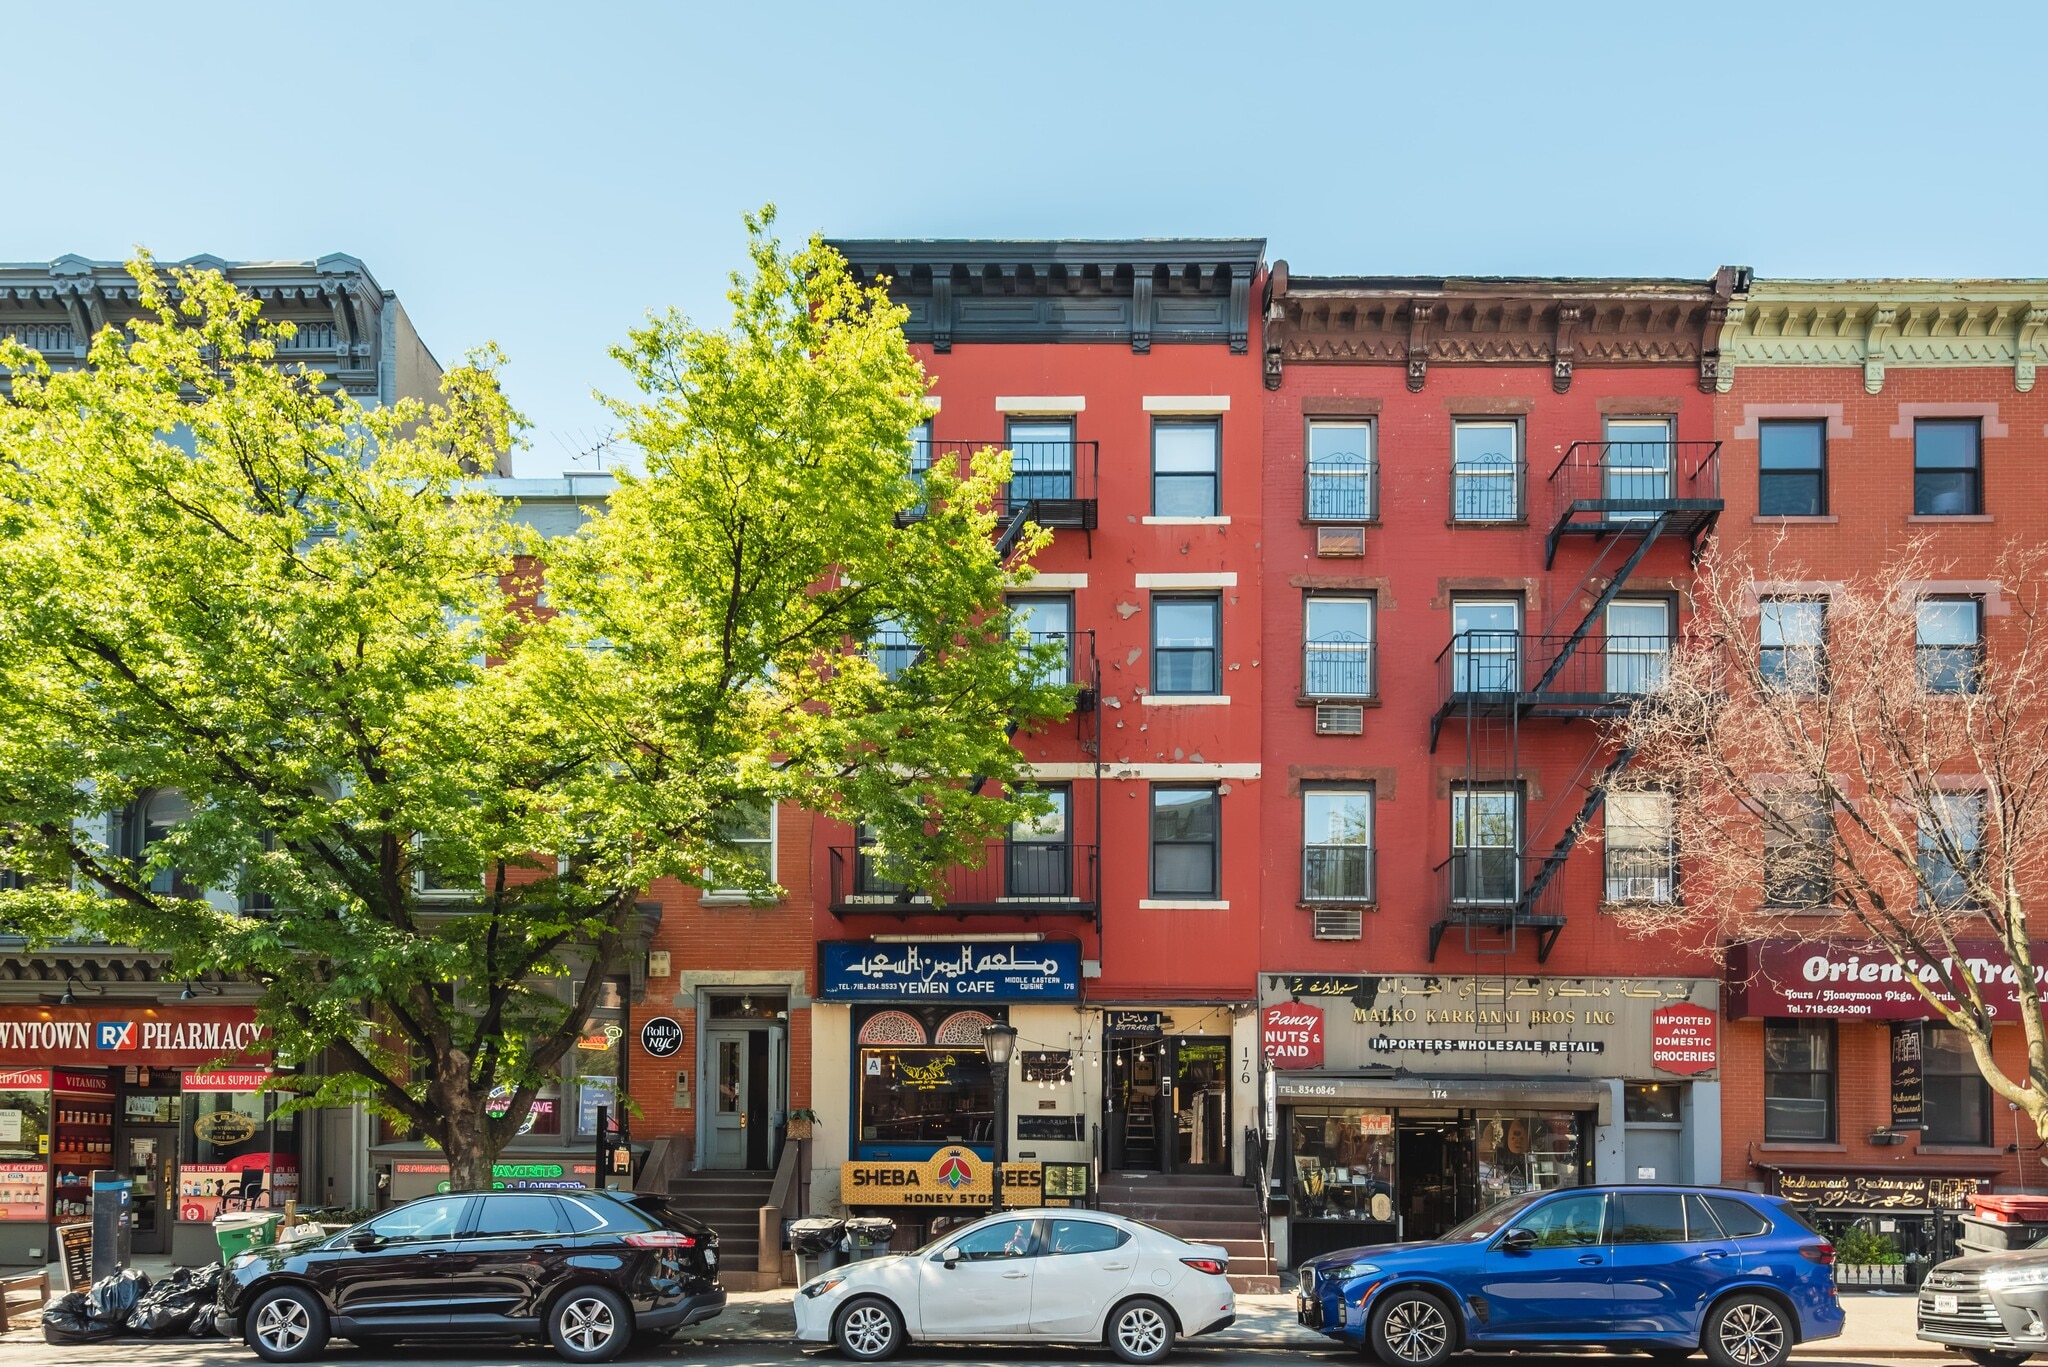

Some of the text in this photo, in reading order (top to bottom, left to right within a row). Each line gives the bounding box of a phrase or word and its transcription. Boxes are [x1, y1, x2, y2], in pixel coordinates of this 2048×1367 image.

[1965, 958, 2048, 983] Trav
[899, 981, 995, 994] YEMEN CAFE
[1785, 989, 1814, 1000] Tours
[1823, 990, 1882, 1001] Honeymoon
[1787, 1005, 1871, 1014] Tel. 718-624-3001
[1118, 1012, 1148, 1023] مدخل
[1268, 1010, 1319, 1030] Fancy
[1352, 1009, 1616, 1025] MALKO KARKANNI BROS INC
[1656, 1016, 1712, 1025] IMPORTED
[102, 1021, 134, 1051] RX
[142, 1022, 265, 1050] PHARMACY
[647, 1026, 680, 1038] Roll Up
[1265, 1031, 1321, 1043] NUTS &
[649, 1037, 676, 1052] NYC
[1549, 1041, 1600, 1052] RETAIL
[1655, 1037, 1712, 1046] DOMESTIC
[1265, 1045, 1309, 1057] CAND
[1653, 1051, 1716, 1062] GROCERIES
[869, 1060, 878, 1070] A
[66, 1076, 107, 1089] VITAMINS
[185, 1075, 268, 1085] SURGICAL SUPPLIES
[1279, 1086, 1298, 1094] TEL.
[1431, 1090, 1448, 1099] 174
[1361, 1122, 1389, 1131] SALE
[12, 1164, 44, 1172] ACCEPTED
[411, 1164, 440, 1173] Atlantic
[853, 1169, 1041, 1186] SHEBA EES
[1779, 1175, 1925, 1190] Hadramout Restaurant
[121, 1190, 128, 1204] P
[904, 1193, 953, 1203] HONEY
